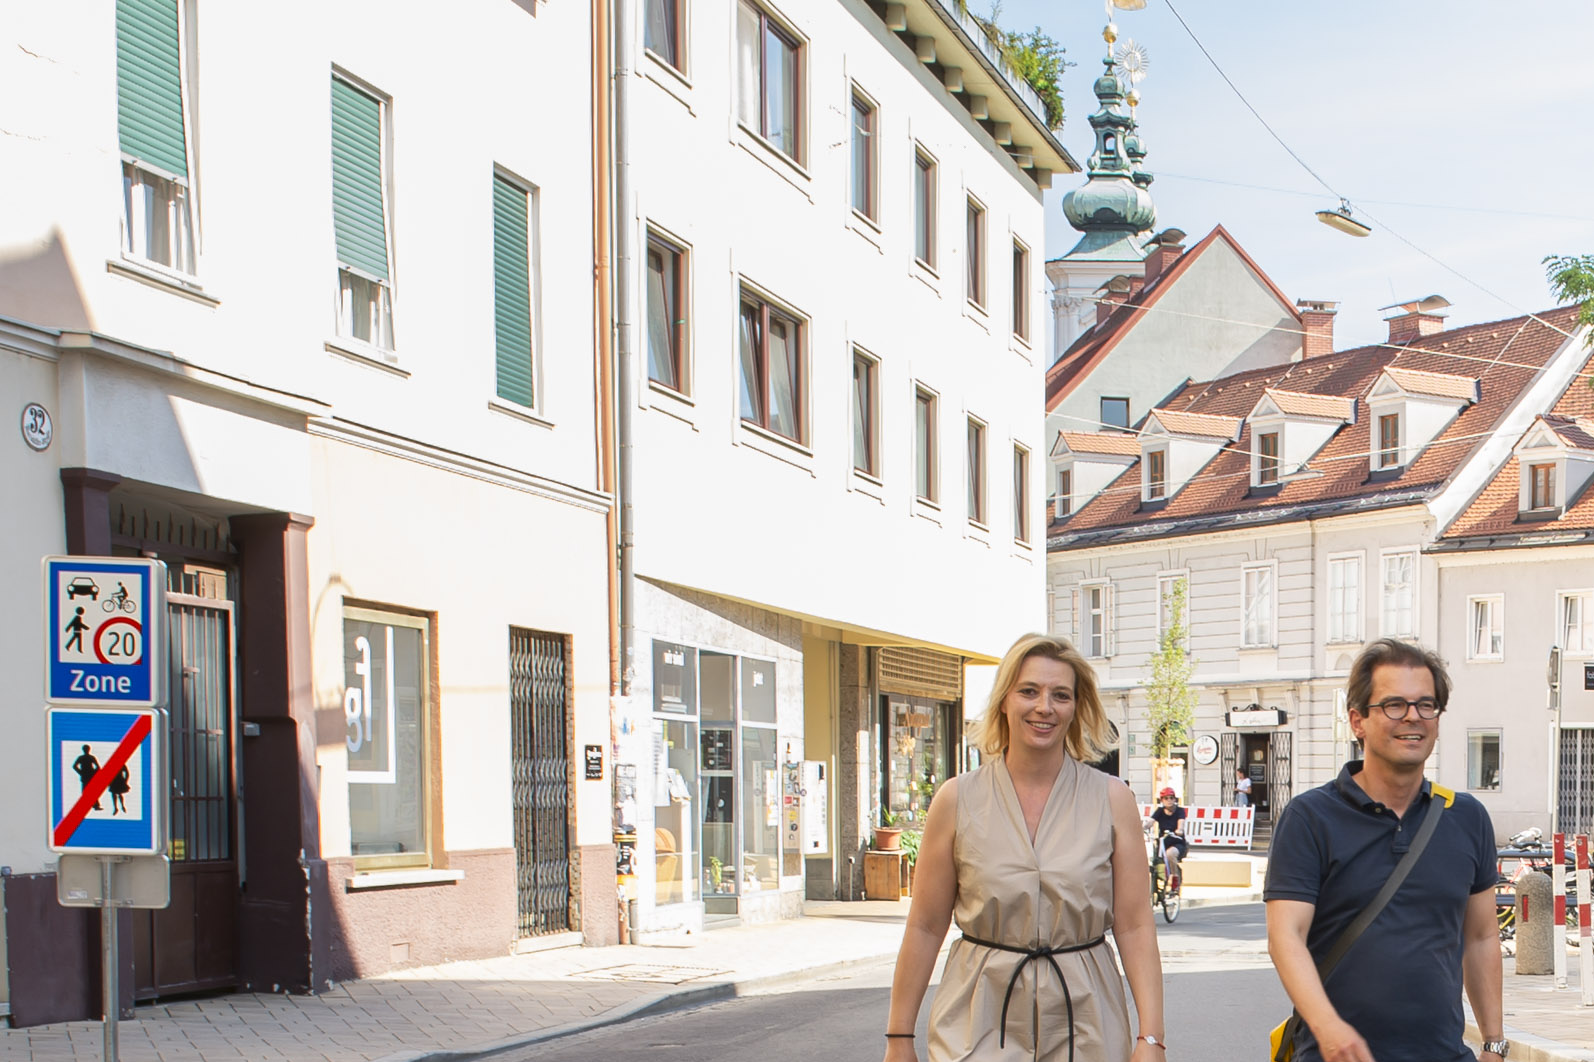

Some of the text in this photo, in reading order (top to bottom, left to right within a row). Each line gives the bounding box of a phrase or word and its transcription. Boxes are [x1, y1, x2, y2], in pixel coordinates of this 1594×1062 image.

[29, 407, 45, 435] 32
[108, 631, 137, 657] 20
[70, 669, 131, 694] Zone
